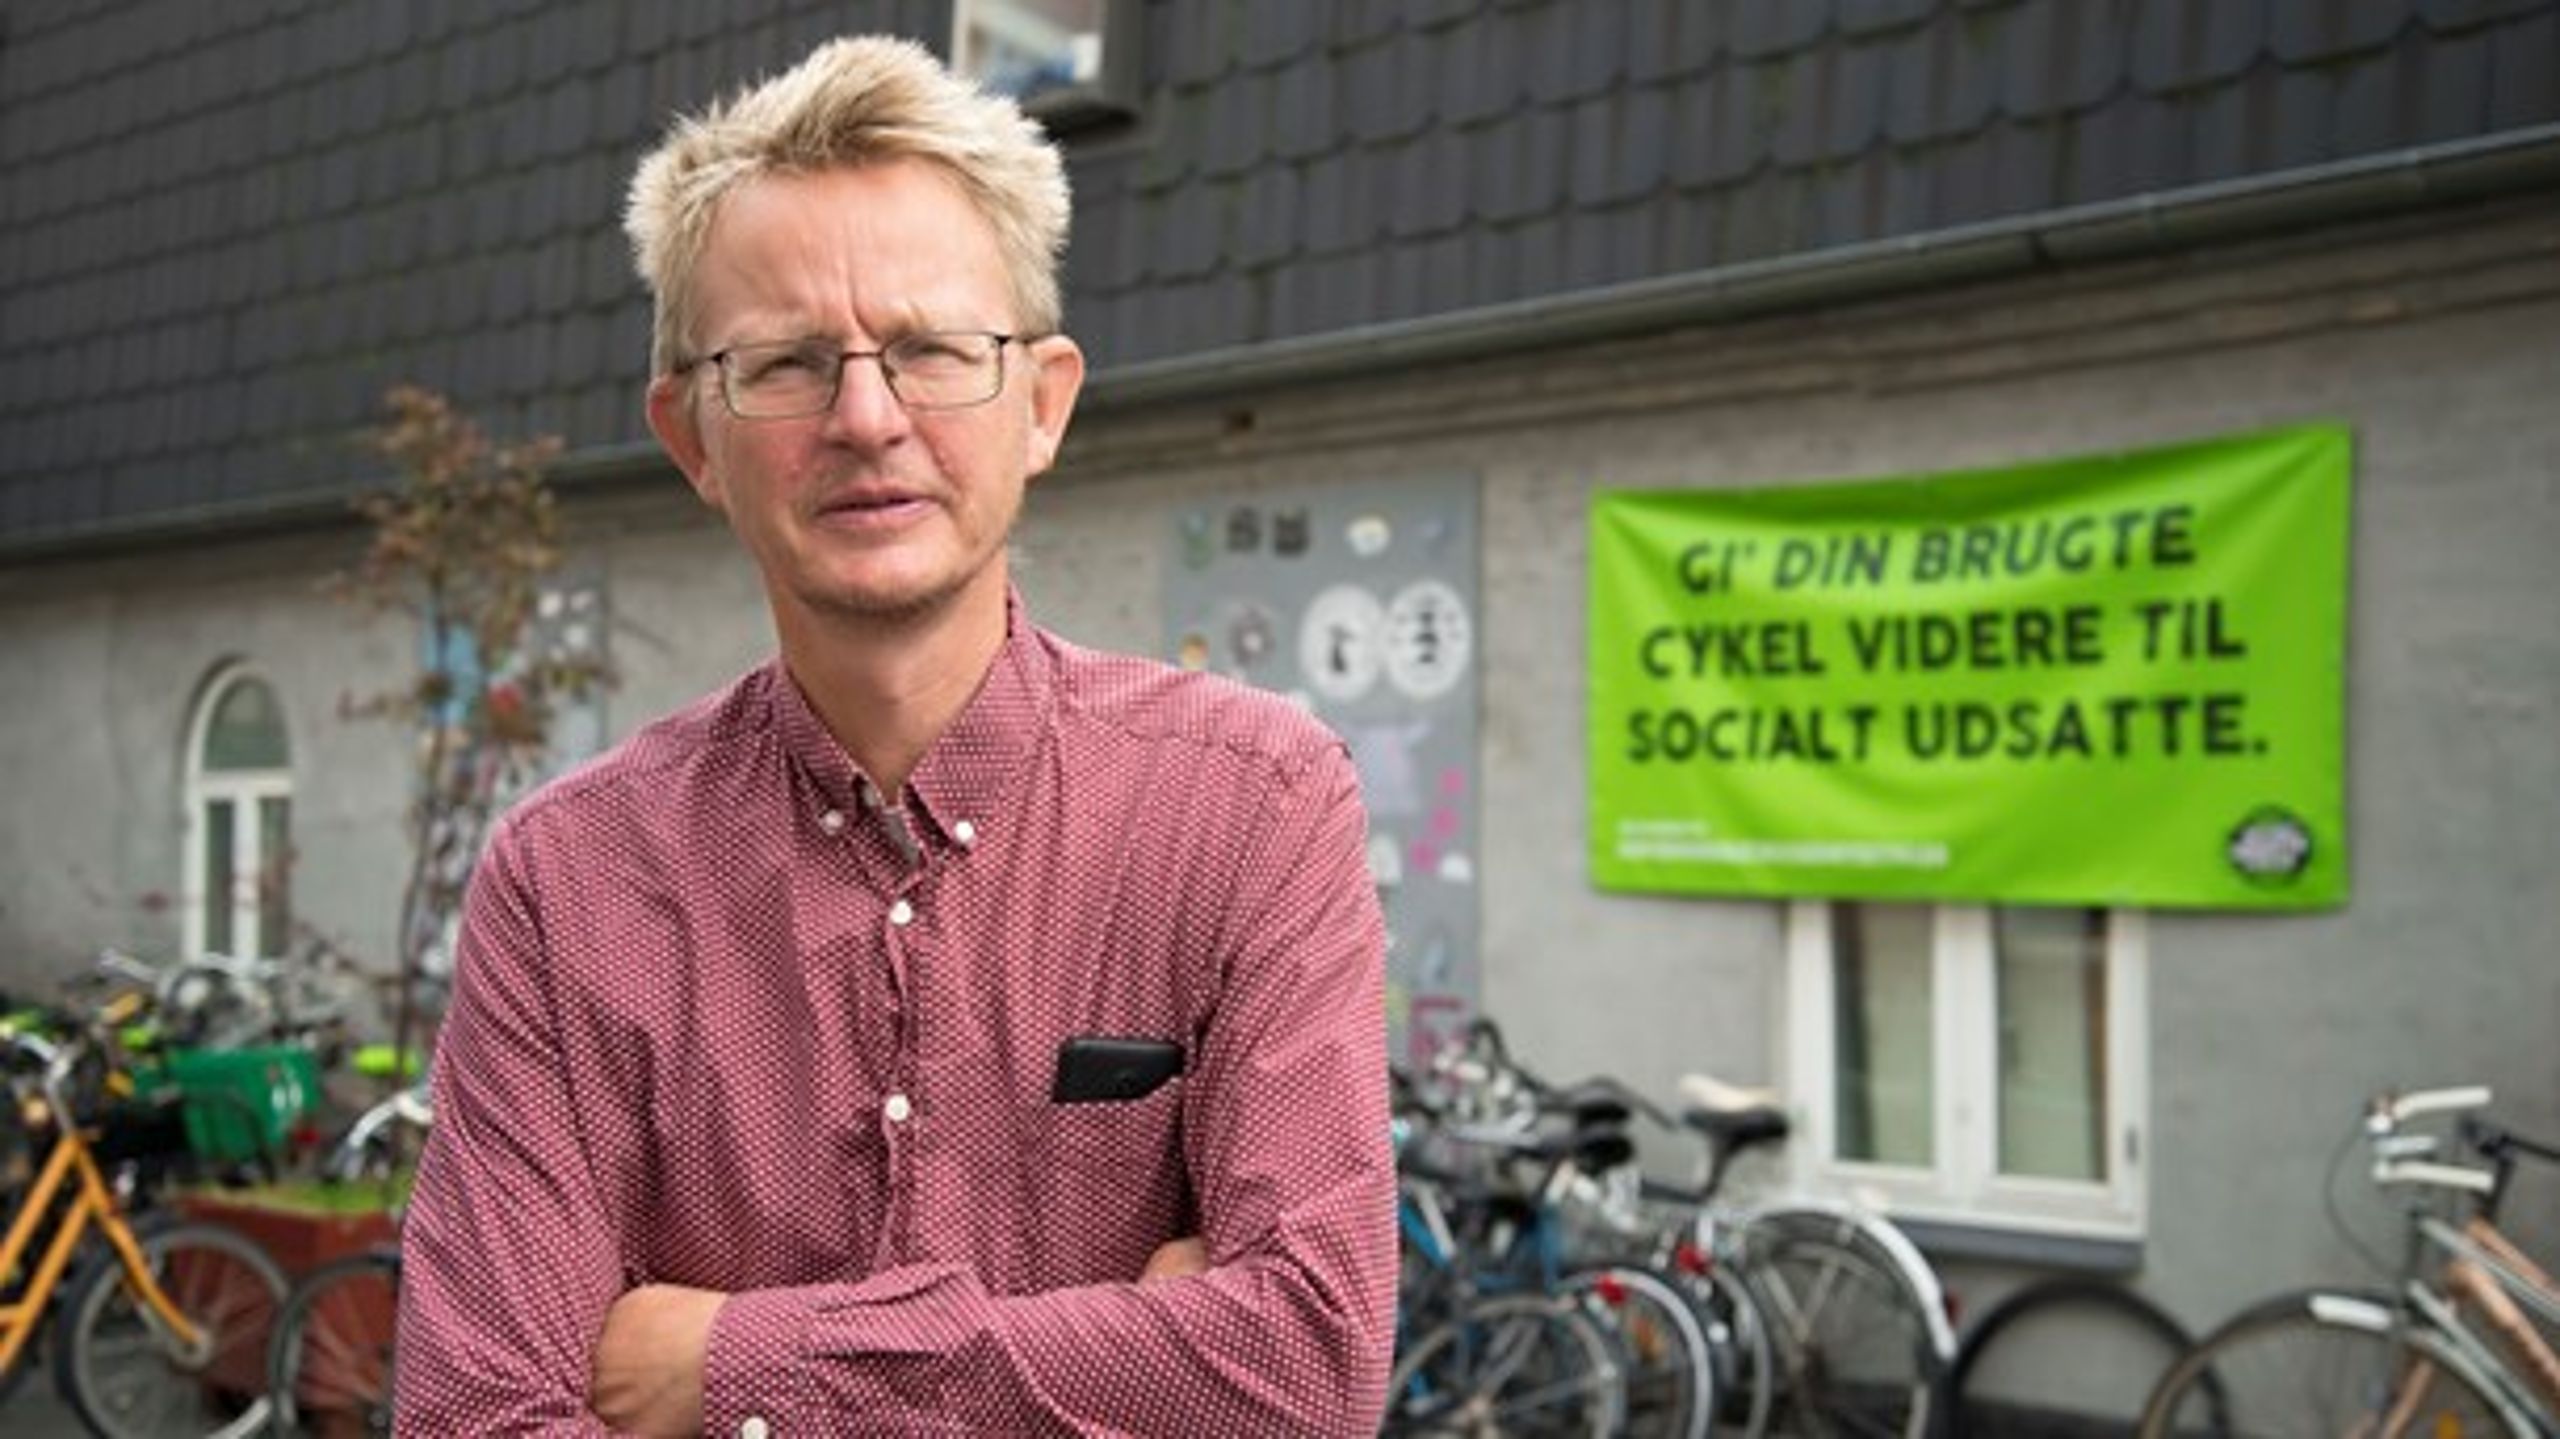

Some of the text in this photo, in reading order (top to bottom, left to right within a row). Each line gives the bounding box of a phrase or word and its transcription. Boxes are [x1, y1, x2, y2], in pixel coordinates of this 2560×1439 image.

[1678, 507, 2195, 594] GI' DIN BRUGTE
[1640, 599, 2246, 678] CYKEL VIDERE TIL
[1628, 696, 2269, 762] SOCIALT UDSATTE.
